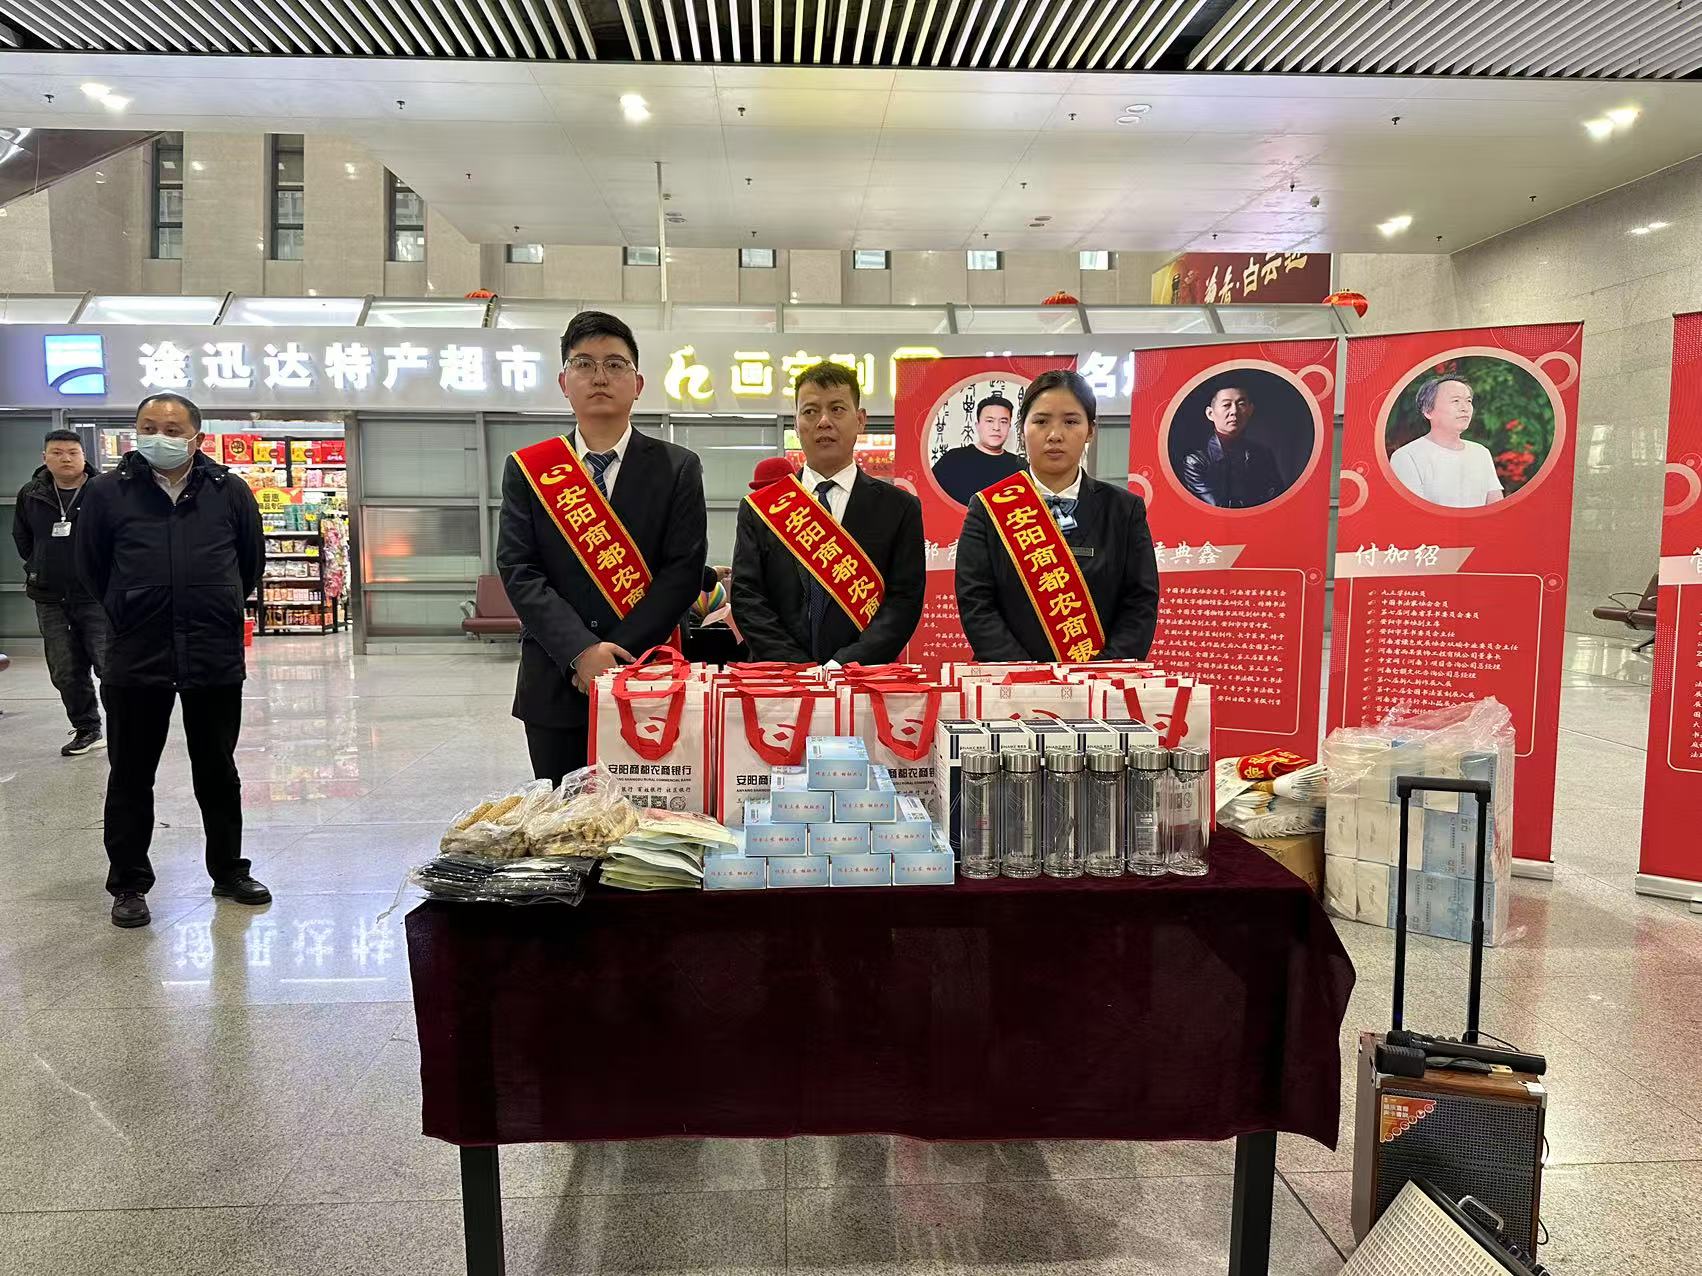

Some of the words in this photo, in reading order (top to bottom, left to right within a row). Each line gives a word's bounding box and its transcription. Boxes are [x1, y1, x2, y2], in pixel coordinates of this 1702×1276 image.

[138, 341, 542, 391] 途迅达特产超市
[1355, 543, 1440, 567] 付加绍
[608, 764, 692, 776] 安阳商都农商银行
[736, 774, 771, 786] 安阳商
